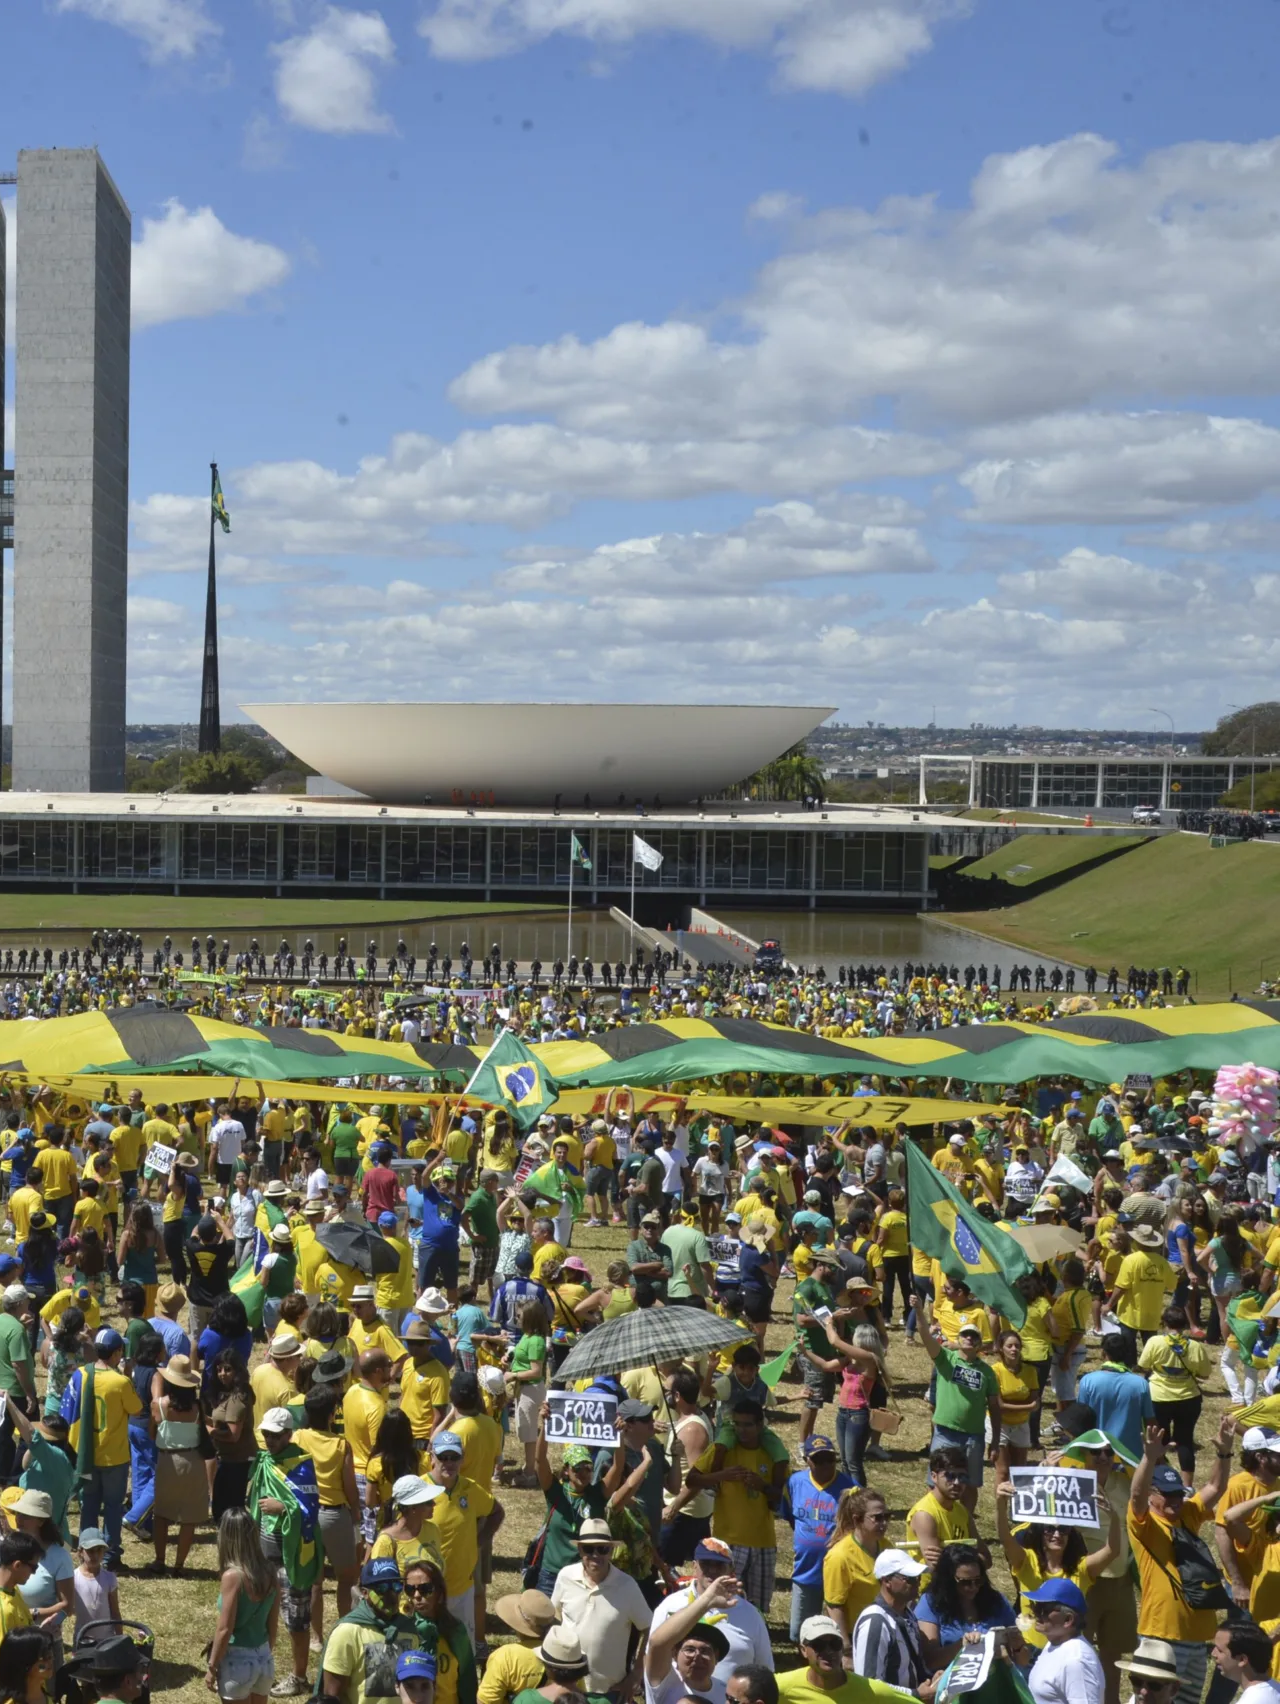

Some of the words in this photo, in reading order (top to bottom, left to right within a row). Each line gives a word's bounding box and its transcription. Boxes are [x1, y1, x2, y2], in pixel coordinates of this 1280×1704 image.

[146, 1151, 170, 1171] Dilma
[153, 1147, 171, 1161] FORA
[711, 1241, 733, 1254] FORA
[959, 1367, 977, 1379] FORA
[563, 1400, 605, 1423] FORA
[549, 1412, 616, 1441] Dilma
[1032, 1475, 1081, 1500] FORA
[804, 1498, 834, 1512] FORA
[1017, 1490, 1094, 1520] Dilma
[949, 1653, 983, 1688] FORA
